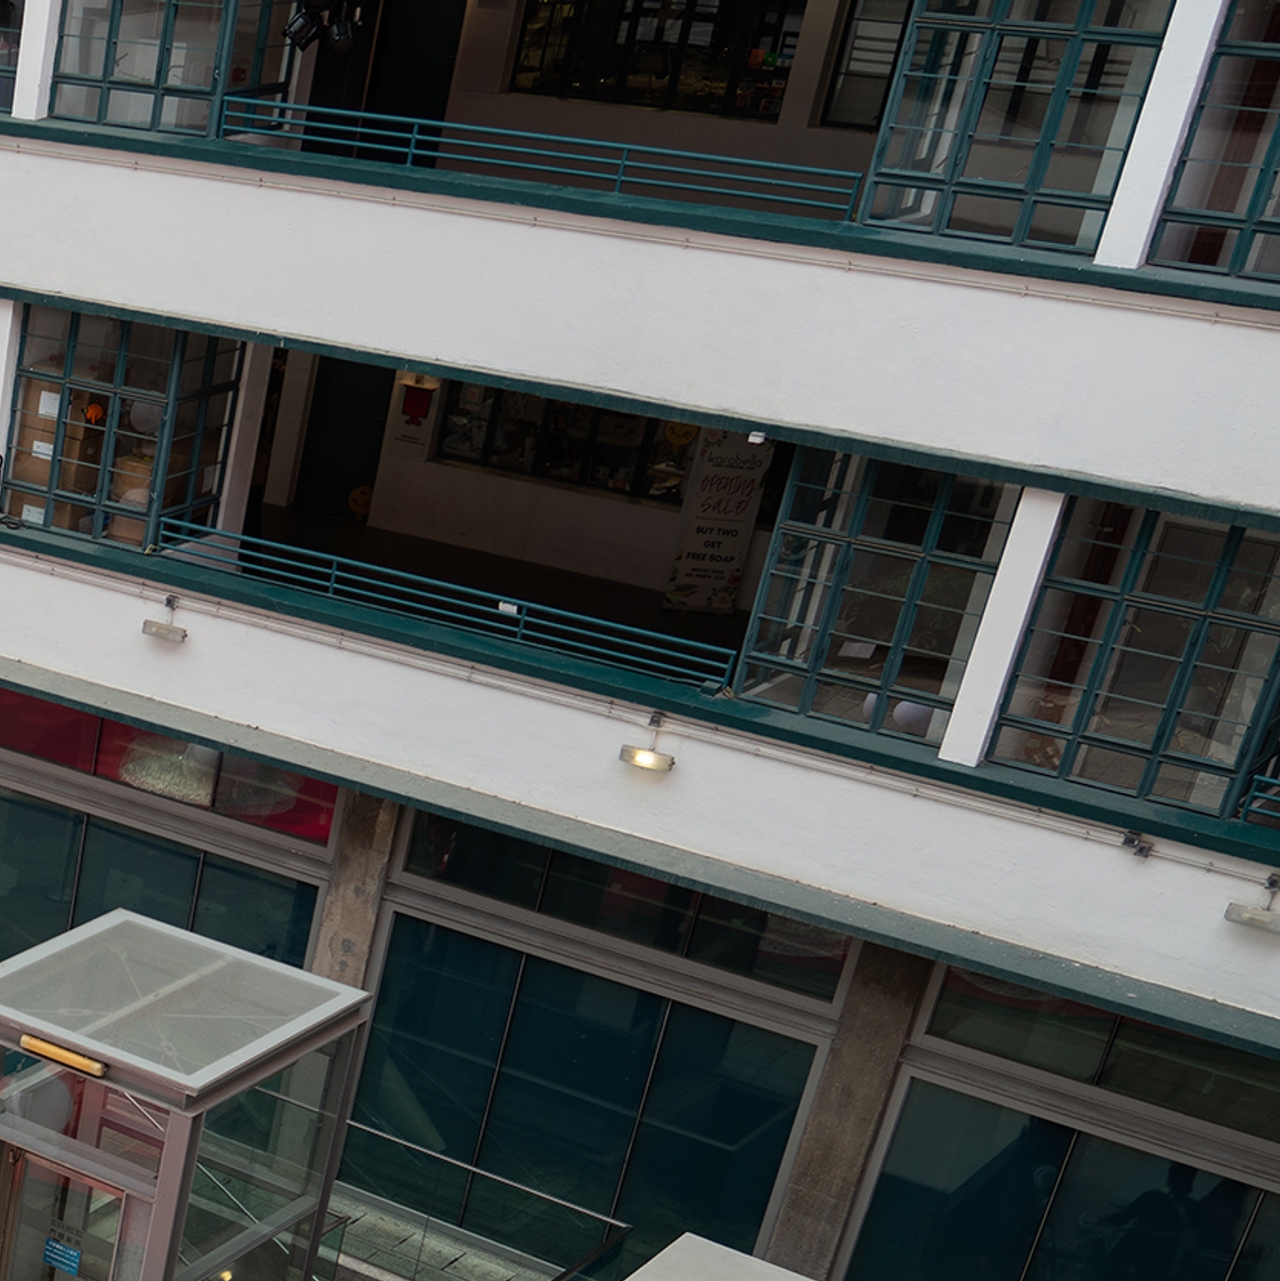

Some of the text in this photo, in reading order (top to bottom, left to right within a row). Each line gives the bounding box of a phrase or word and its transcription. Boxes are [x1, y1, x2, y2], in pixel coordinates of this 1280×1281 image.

[700, 472, 758, 496] OPENING
[695, 525, 739, 538] BUY TWO
[703, 540, 723, 550] GET
[686, 551, 735, 564] FREE SOAP
